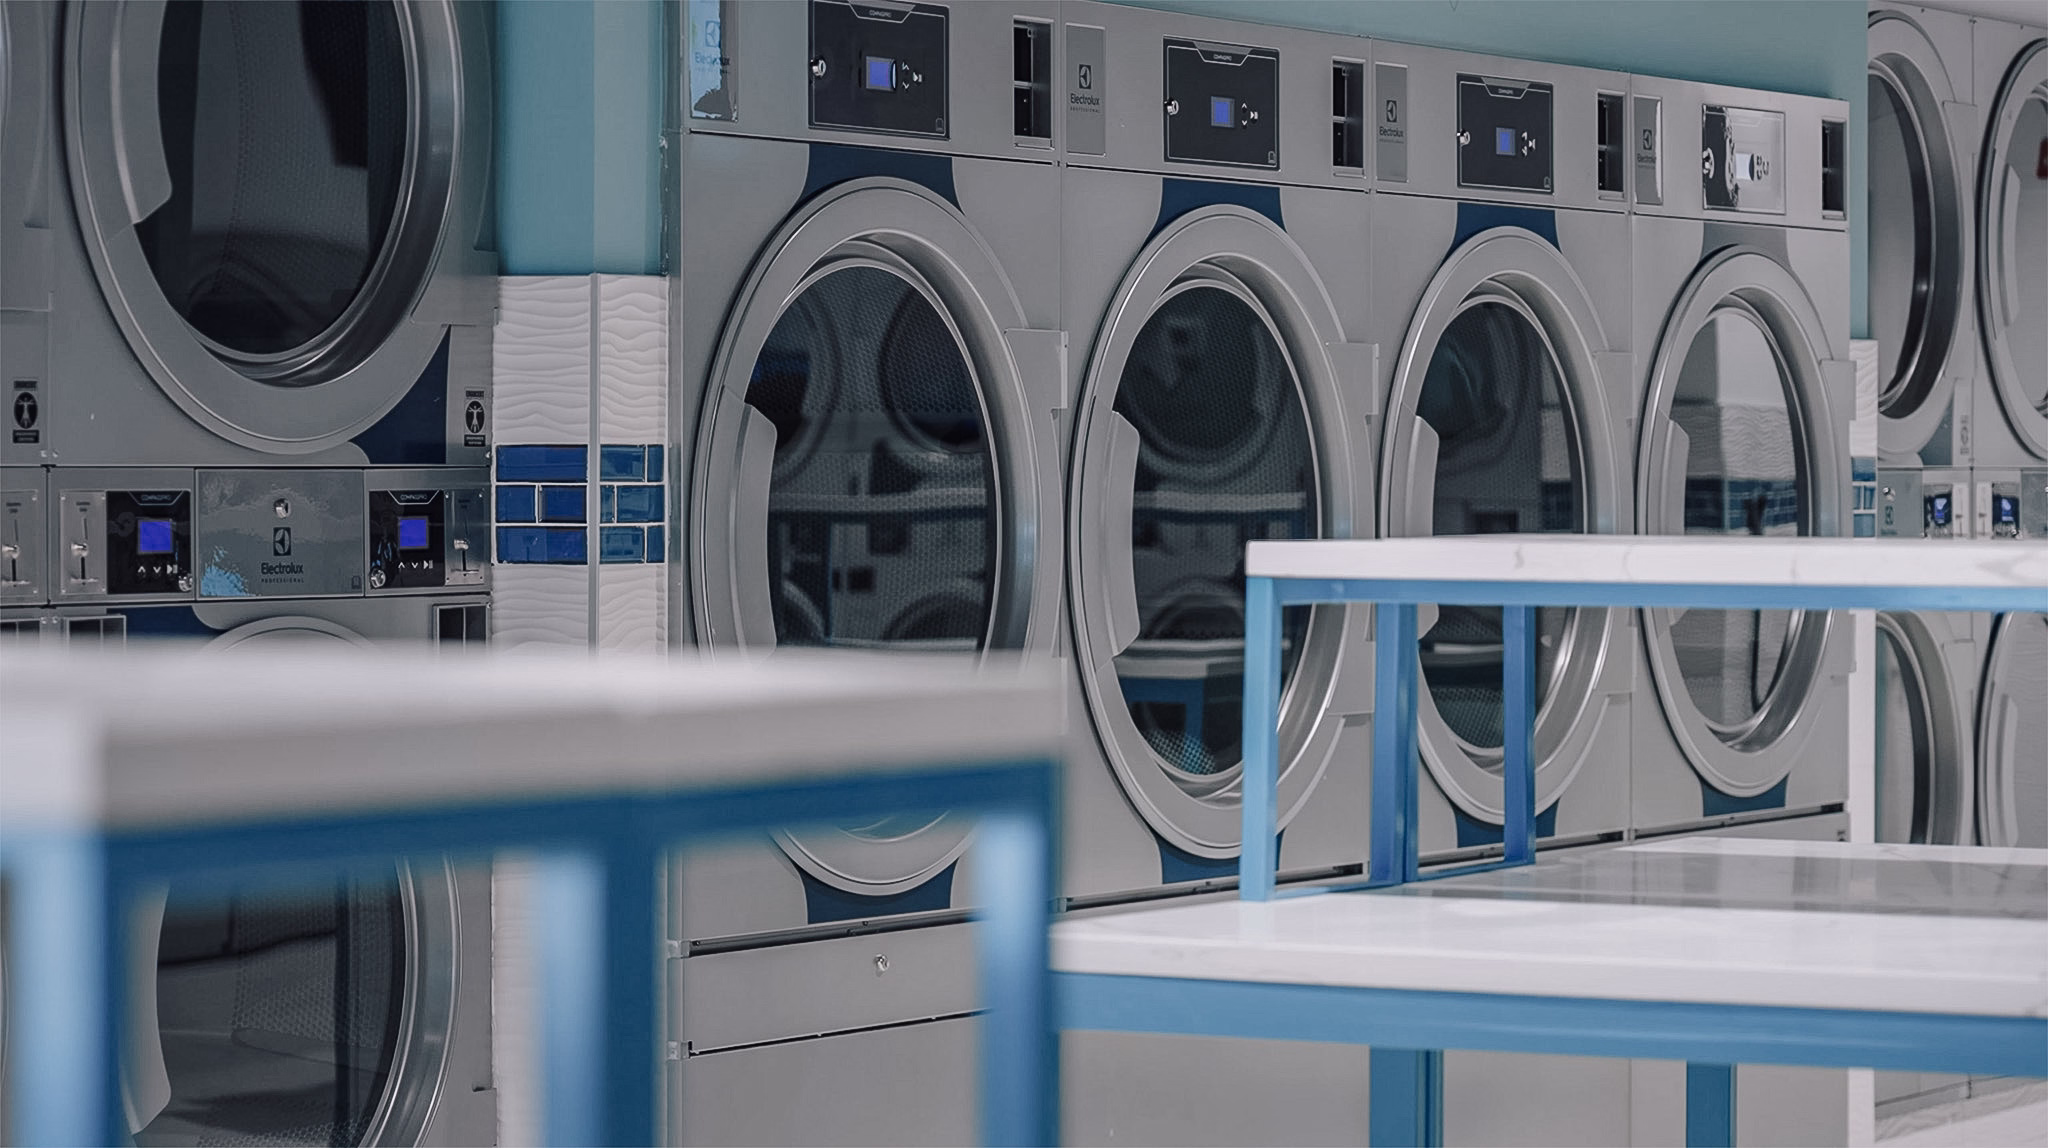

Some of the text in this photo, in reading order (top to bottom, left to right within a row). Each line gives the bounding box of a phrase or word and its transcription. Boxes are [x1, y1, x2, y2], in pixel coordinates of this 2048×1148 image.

[1070, 92, 1100, 105] Electrolux
[1379, 126, 1404, 137] Electrolux
[261, 562, 304, 574] Electrolux
